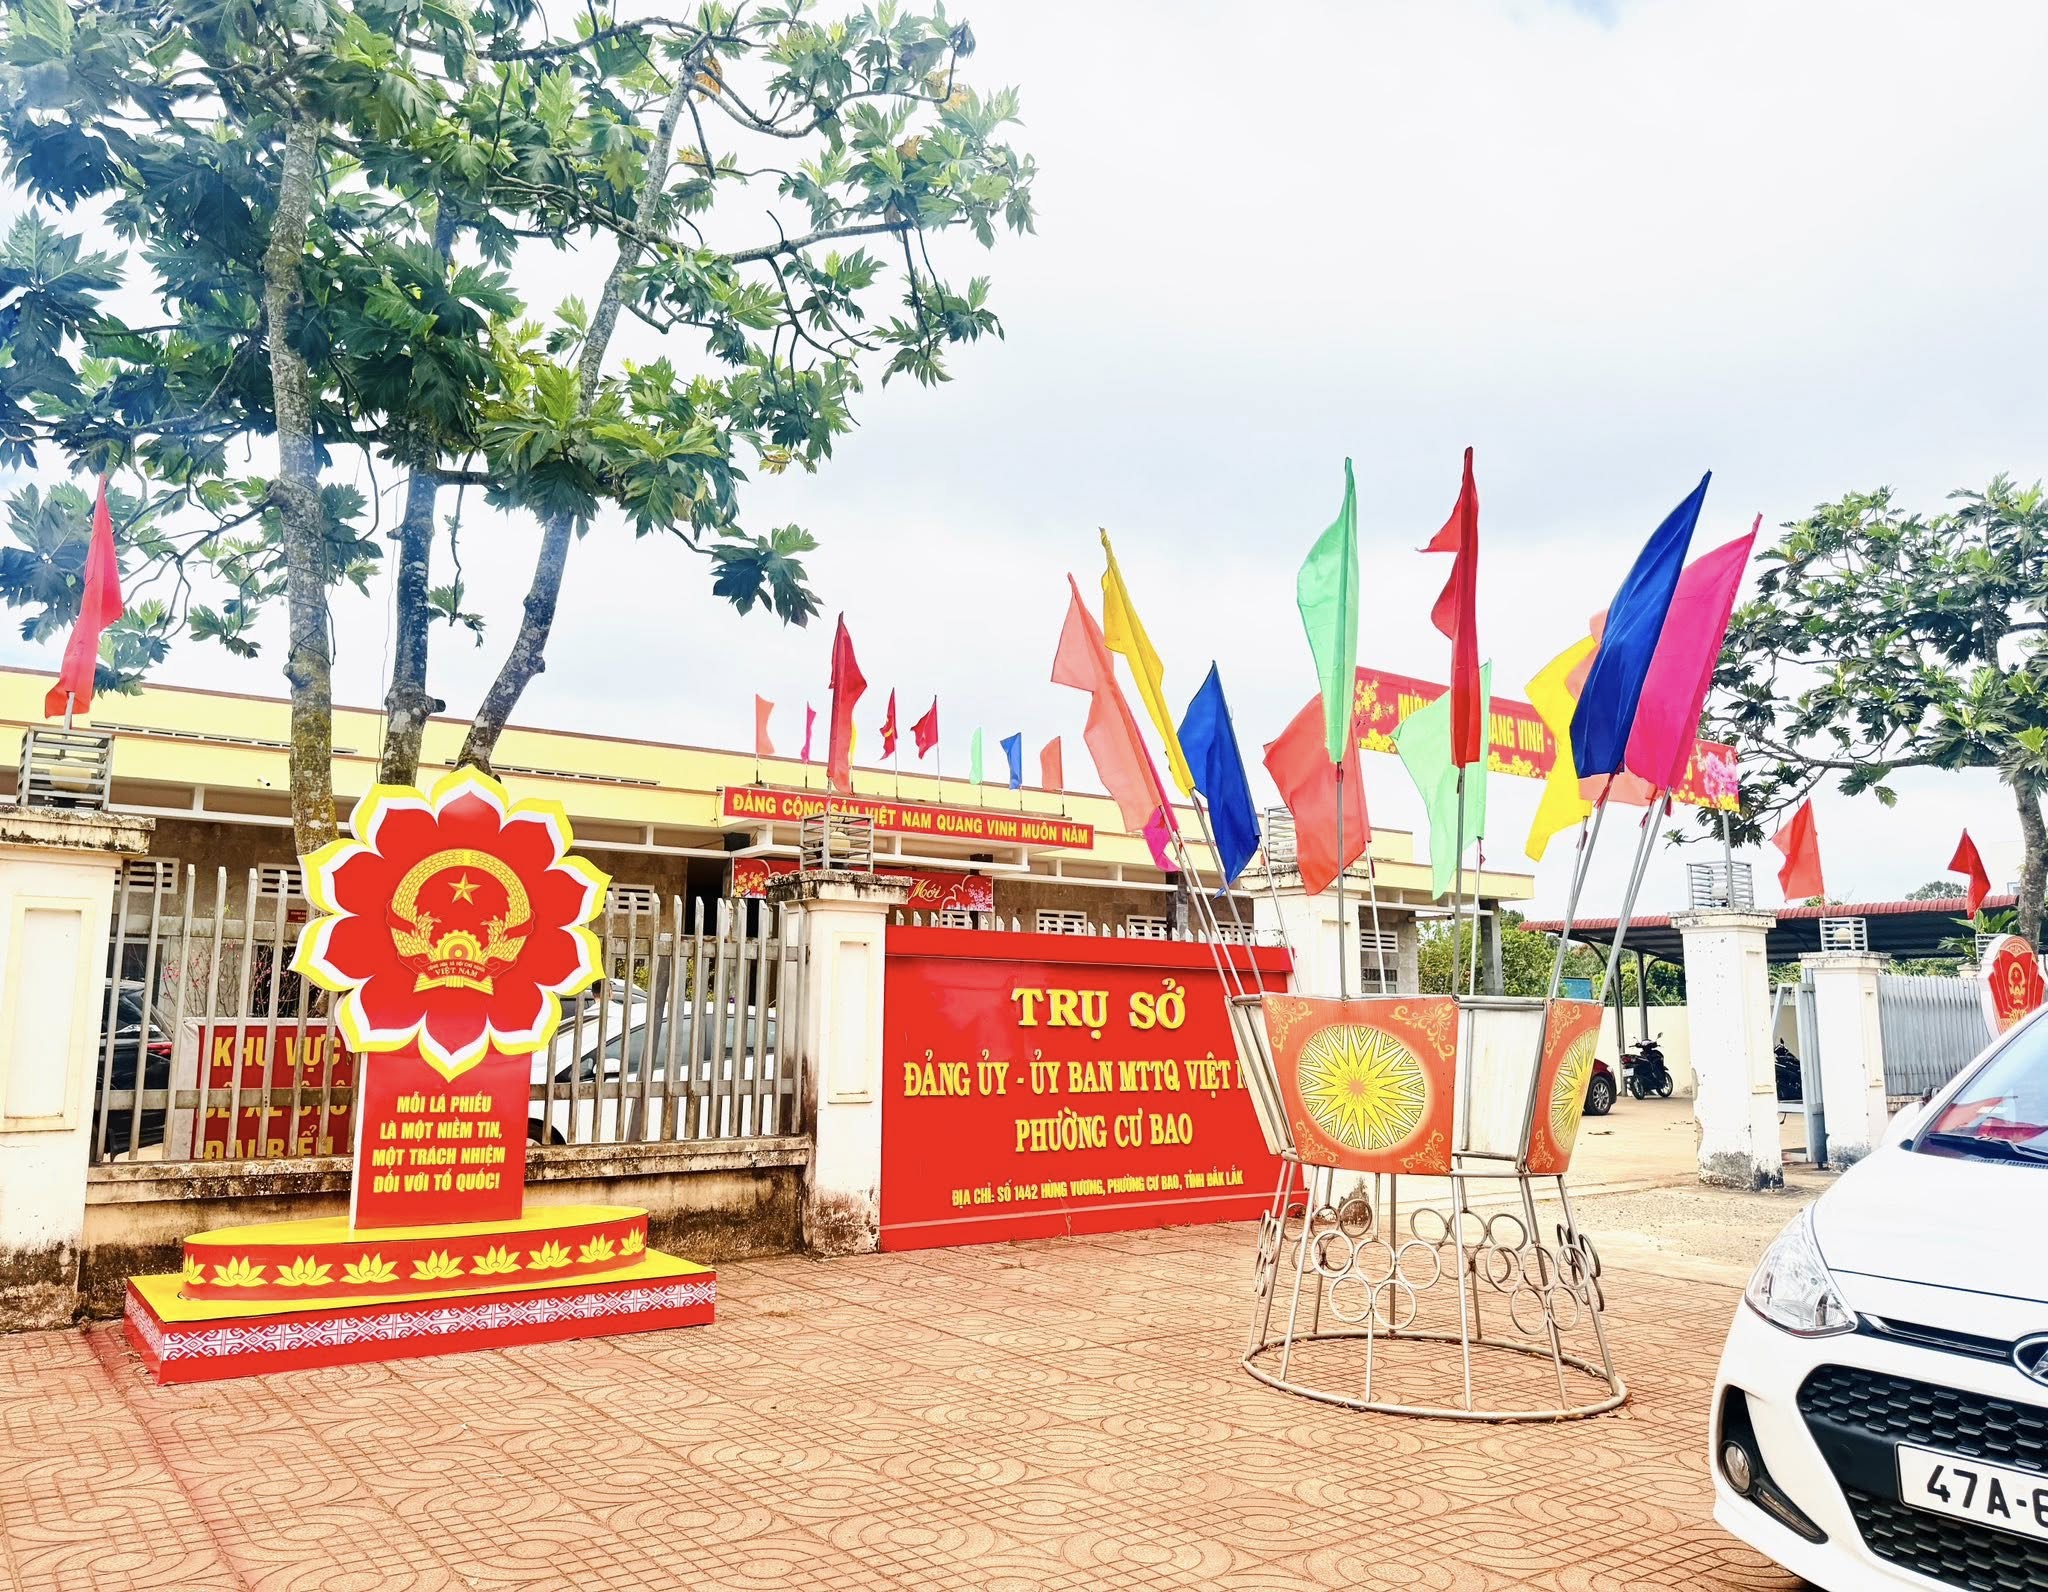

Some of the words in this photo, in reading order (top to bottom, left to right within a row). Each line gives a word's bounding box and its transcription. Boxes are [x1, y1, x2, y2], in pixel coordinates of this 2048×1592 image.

[1517, 718, 1544, 753] VINH
[733, 790, 776, 814] ĐẢNG
[782, 796, 826, 819] CỘNG
[864, 805, 896, 827] VIỆT
[902, 810, 931, 828] NAM
[936, 814, 982, 833] QUANG
[987, 819, 1017, 837] VINH
[1021, 821, 1057, 841] MUÔN
[1062, 825, 1088, 844] NĂM
[435, 965, 456, 976] VIỆT
[458, 966, 478, 977] NAM
[1010, 987, 1109, 1040] TRỤ
[1128, 978, 1186, 1030] SỞ
[903, 1048, 971, 1096] ĐẢNG
[976, 1048, 1009, 1096] ỦY
[1029, 1048, 1060, 1095] ỦY
[1068, 1061, 1113, 1093] BAN
[1118, 1059, 1180, 1092] MTTQ
[1184, 1051, 1231, 1099] VIỆT
[396, 1091, 426, 1113] MỖI
[429, 1093, 446, 1113] LÁ
[450, 1090, 492, 1113] PHIẾU
[380, 1120, 397, 1140] LÀ
[401, 1119, 434, 1142] MỘT
[437, 1116, 473, 1139] NIỀM
[477, 1121, 502, 1139] TIN,
[1015, 1106, 1108, 1152] PHƯỜNG
[1114, 1107, 1143, 1148] CƯ
[1149, 1112, 1193, 1145] BAO
[372, 1146, 405, 1169] MỘT
[409, 1145, 457, 1165] TRÁCH
[460, 1144, 506, 1167] NHIỆM
[373, 1169, 400, 1193] ĐỐI
[404, 1172, 429, 1192] VỚI
[433, 1168, 452, 1191] TỔ
[456, 1167, 500, 1192] QUỐC!
[951, 1189, 971, 1209] ĐỊA
[973, 1182, 995, 1204] CHỈ:
[997, 1179, 1012, 1202] SỐ
[1014, 1183, 1038, 1201] 1442
[1040, 1178, 1068, 1198] HÙNG
[1070, 1179, 1106, 1197] VƯƠNG,
[1107, 1173, 1145, 1194] PHƯỜNG
[1146, 1175, 1159, 1191] CƯ
[1161, 1174, 1182, 1190] BAO,
[1184, 1169, 1205, 1189] TỈNH
[1207, 1165, 1225, 1187] ĐẮK
[1225, 1164, 1244, 1185] LẮK
